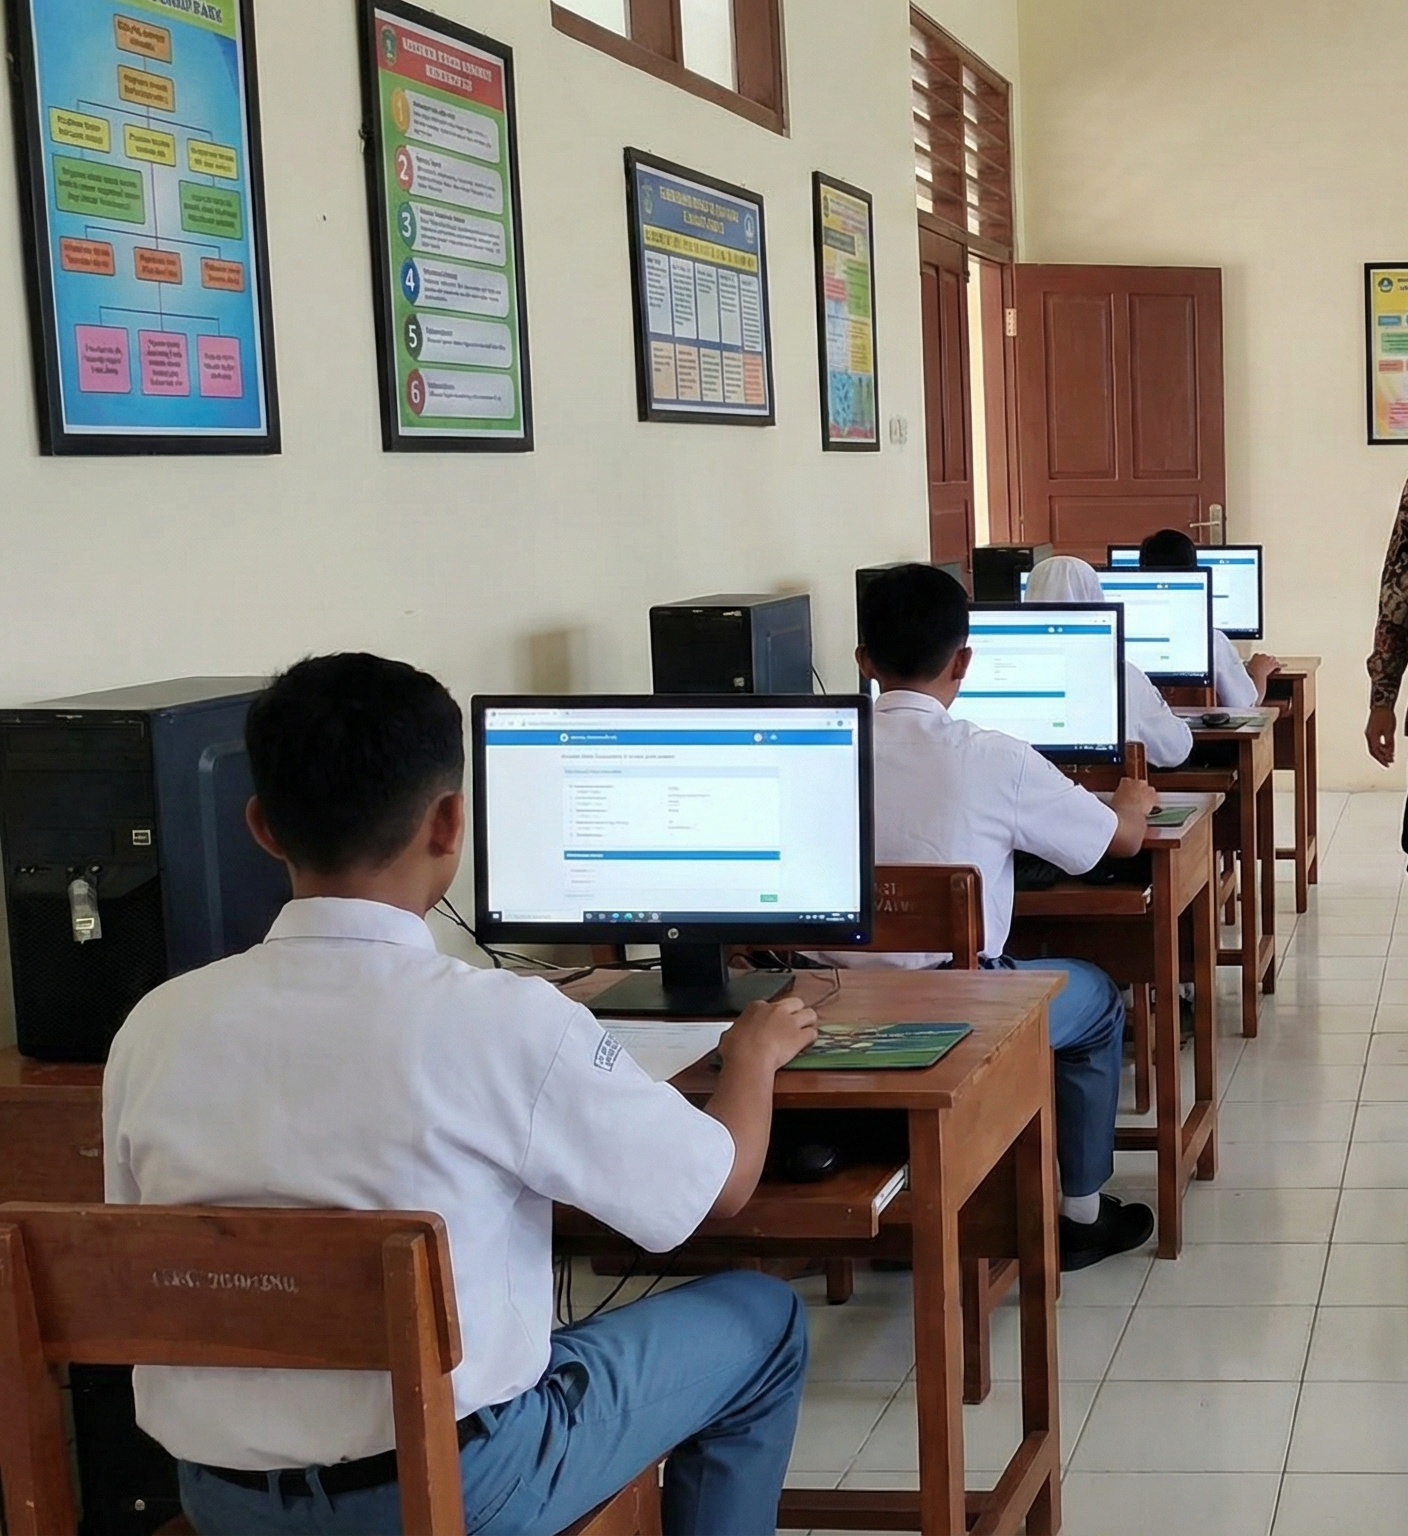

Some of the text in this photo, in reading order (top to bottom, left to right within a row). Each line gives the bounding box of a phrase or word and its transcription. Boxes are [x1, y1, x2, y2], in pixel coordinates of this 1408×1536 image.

[398, 155, 409, 181] 2
[401, 211, 412, 238] 3
[405, 267, 415, 292] 4
[408, 325, 418, 348] 5
[411, 380, 420, 404] 6
